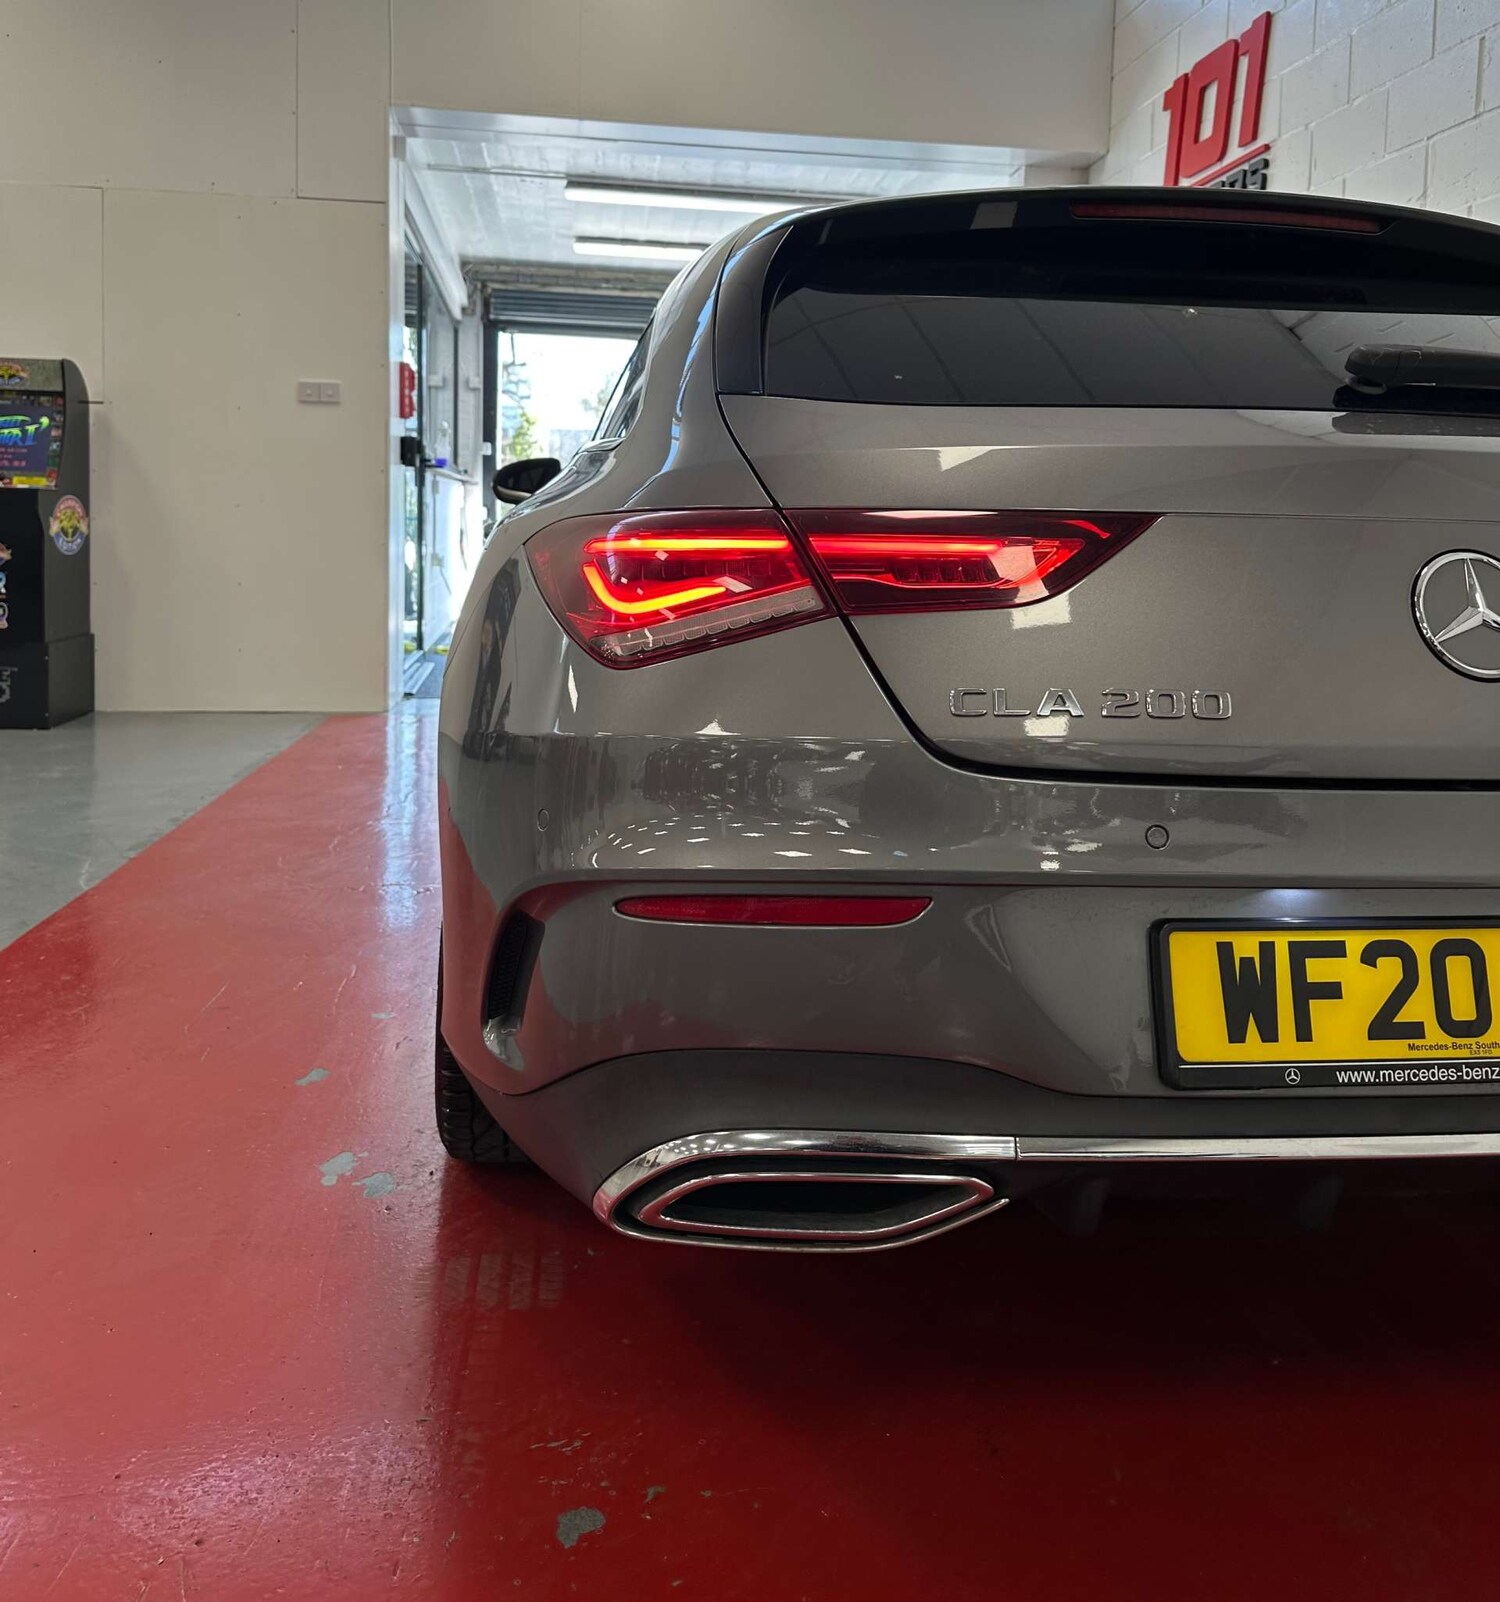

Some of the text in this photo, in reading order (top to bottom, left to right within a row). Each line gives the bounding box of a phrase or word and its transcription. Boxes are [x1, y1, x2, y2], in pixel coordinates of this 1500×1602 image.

[1163, 11, 1271, 187] 101
[949, 687, 1232, 720] CLA 200
[1216, 938, 1492, 1043] WF20
[1408, 1041, 1473, 1051] Mercedes-Benz
[1336, 1064, 1500, 1083] www.mercedes-benz
